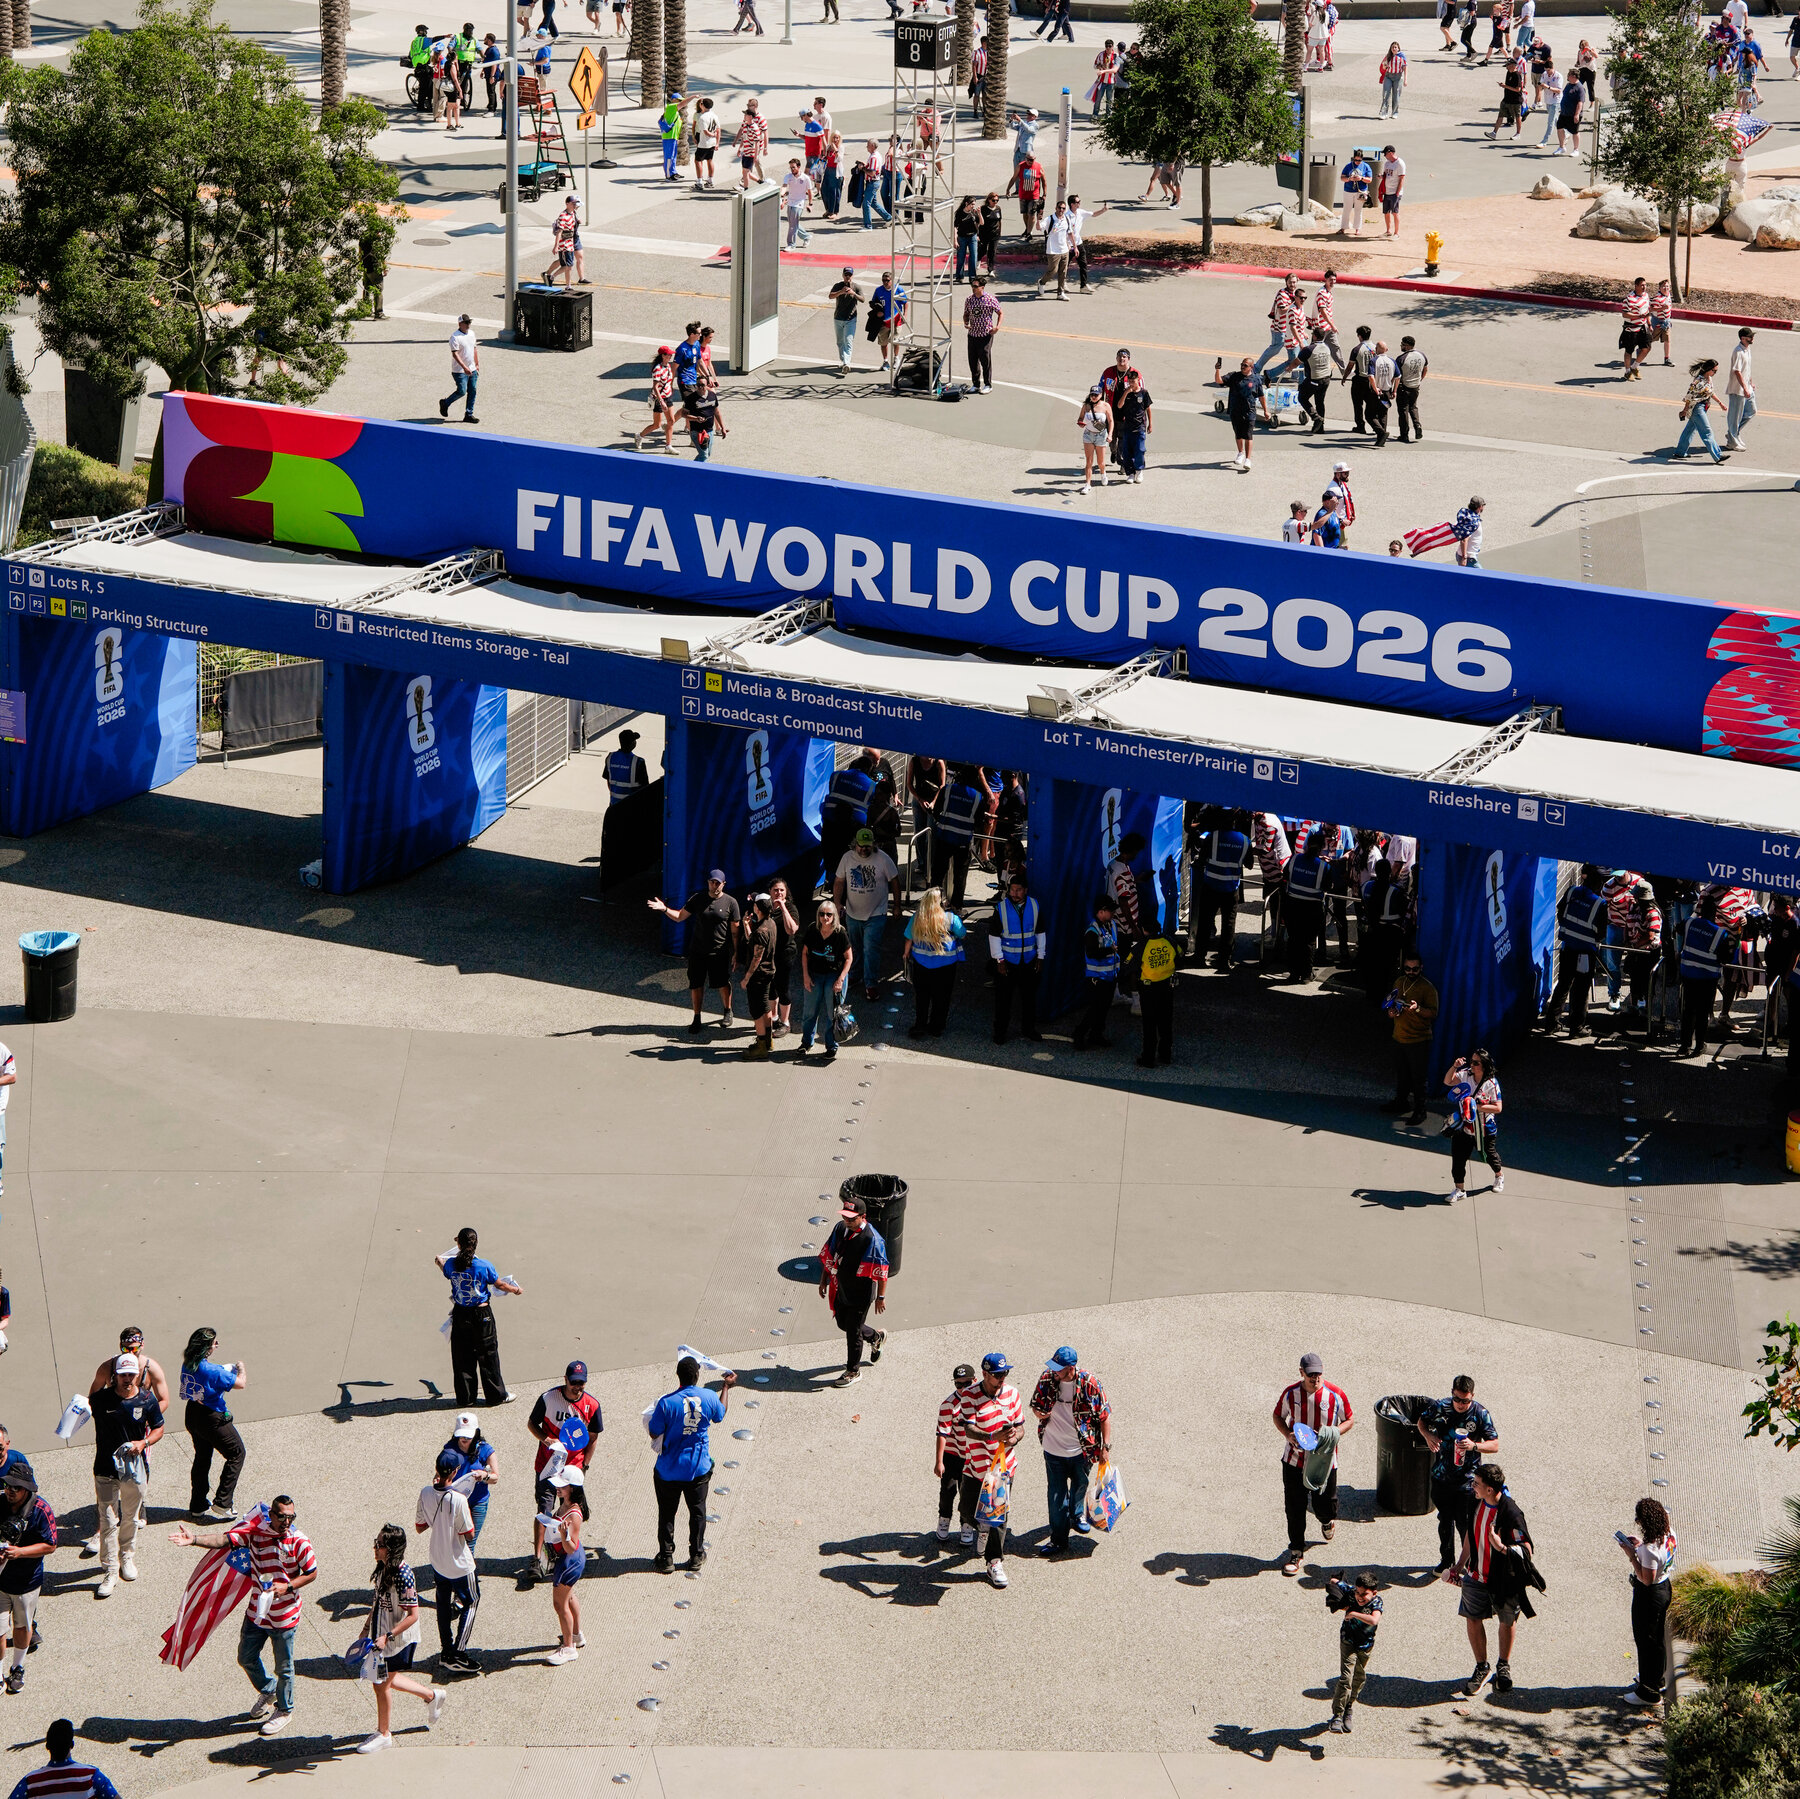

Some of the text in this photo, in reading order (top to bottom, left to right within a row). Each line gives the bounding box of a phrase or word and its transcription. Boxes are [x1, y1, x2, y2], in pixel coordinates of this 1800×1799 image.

[898, 27, 933, 42] ENTRY
[939, 24, 957, 41] ENTRY
[910, 43, 920, 62] 8
[944, 41, 950, 60] 8
[50, 575, 78, 589] Lots
[82, 579, 93, 594] R,
[97, 582, 105, 593] S
[516, 488, 681, 572] FIFA
[694, 513, 992, 614] WORLD
[1010, 560, 1180, 640] CUP
[1198, 587, 1513, 693] 2026
[33, 600, 208, 636] P3 P4 P11 Parking Structure
[359, 620, 428, 643] Restricted
[432, 632, 472, 649] Items
[476, 639, 529, 660] Storage
[541, 649, 569, 665] Teal
[104, 684, 116, 695] FIFA
[97, 698, 125, 714] WORLD CUP
[708, 678, 922, 721] SYS Media & Broadcast Shuttle
[98, 706, 126, 726] 2026
[706, 704, 863, 739] Broadcast Compound
[418, 734, 429, 745] FIFA
[414, 748, 438, 765] WORLD CUP
[1044, 729, 1068, 746] Lot
[1073, 733, 1082, 746] T
[1096, 737, 1247, 774] Manchester/Prairie
[416, 757, 441, 777] 2026
[756, 790, 768, 802] FIFA
[1429, 790, 1510, 814] Rideshare
[750, 804, 775, 823] WORLD CUP
[751, 813, 776, 836] 2026
[1762, 840, 1790, 858] Lot
[1708, 862, 1737, 879] VIP
[1150, 946, 1168, 955] CSC
[1150, 959, 1170, 968] STAFF
